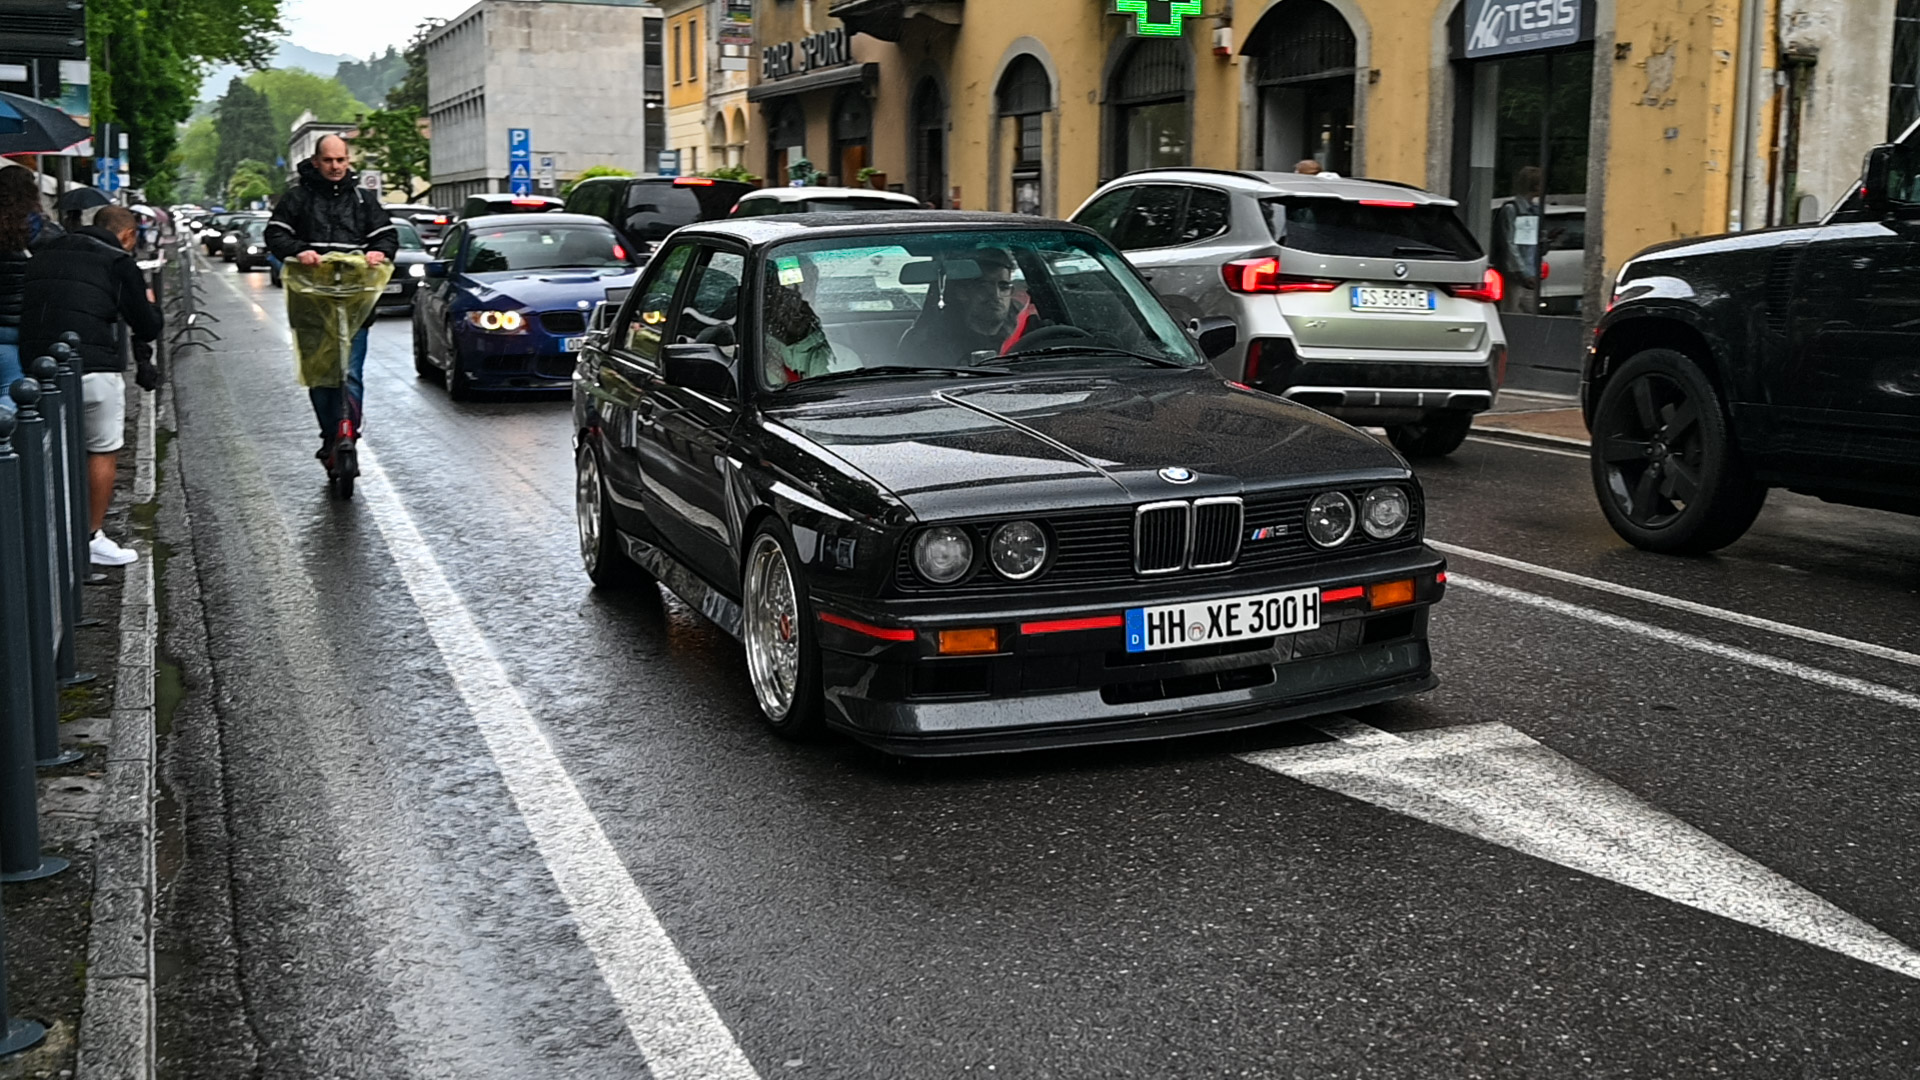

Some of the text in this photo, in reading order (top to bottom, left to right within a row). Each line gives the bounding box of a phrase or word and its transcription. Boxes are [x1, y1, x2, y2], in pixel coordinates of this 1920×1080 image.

[1505, 0, 1575, 31] TESIS
[762, 27, 850, 78] BAR SPORT
[512, 130, 526, 146] P
[1361, 289, 1426, 308] GS 386ME
[1147, 609, 1186, 646] HH
[1207, 603, 1243, 639] XE
[1131, 634, 1140, 645] D
